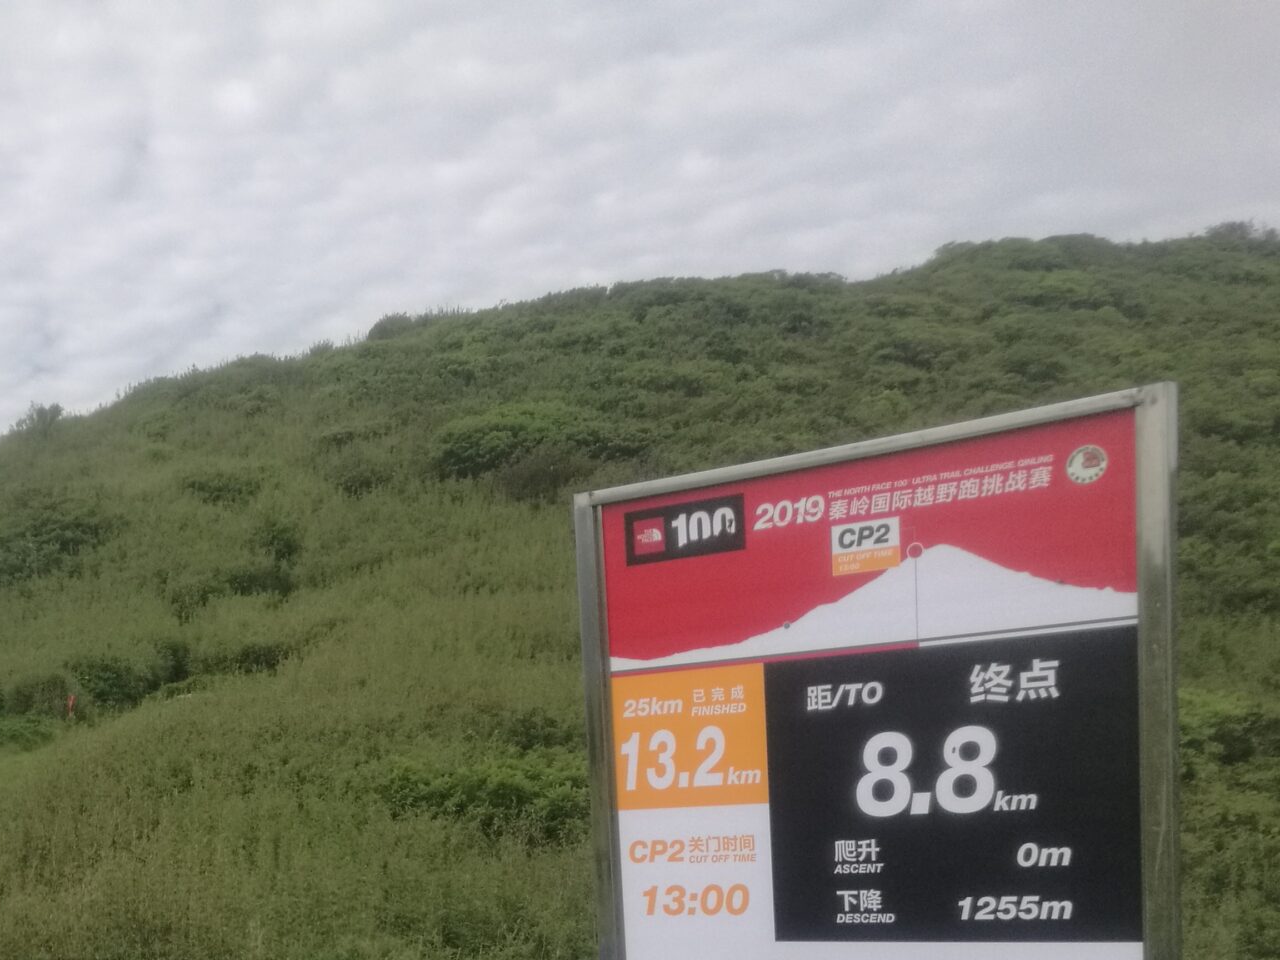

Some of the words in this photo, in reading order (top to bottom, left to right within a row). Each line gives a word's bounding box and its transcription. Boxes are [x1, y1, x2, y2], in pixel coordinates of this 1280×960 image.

[829, 466, 1053, 520] 秦岭国际越野跑挑战赛
[753, 495, 824, 531] 2019
[838, 524, 891, 549] CP2
[969, 658, 1061, 703] 终点
[623, 698, 683, 717] 25km
[807, 681, 884, 711] 距/TO
[691, 703, 746, 717] FINISHED
[628, 840, 685, 863] CP2
[688, 834, 755, 853] 关门时间
[834, 839, 880, 862] 爬升
[1016, 842, 1072, 867] 0m
[689, 855, 708, 864] CUT
[711, 854, 730, 863] OFF
[734, 853, 757, 862] TIME
[834, 863, 884, 874] ASCENT
[642, 883, 750, 916] 13:00
[836, 889, 882, 912] 下降
[958, 895, 1072, 920] 1255m
[836, 913, 895, 923] DESCEND
